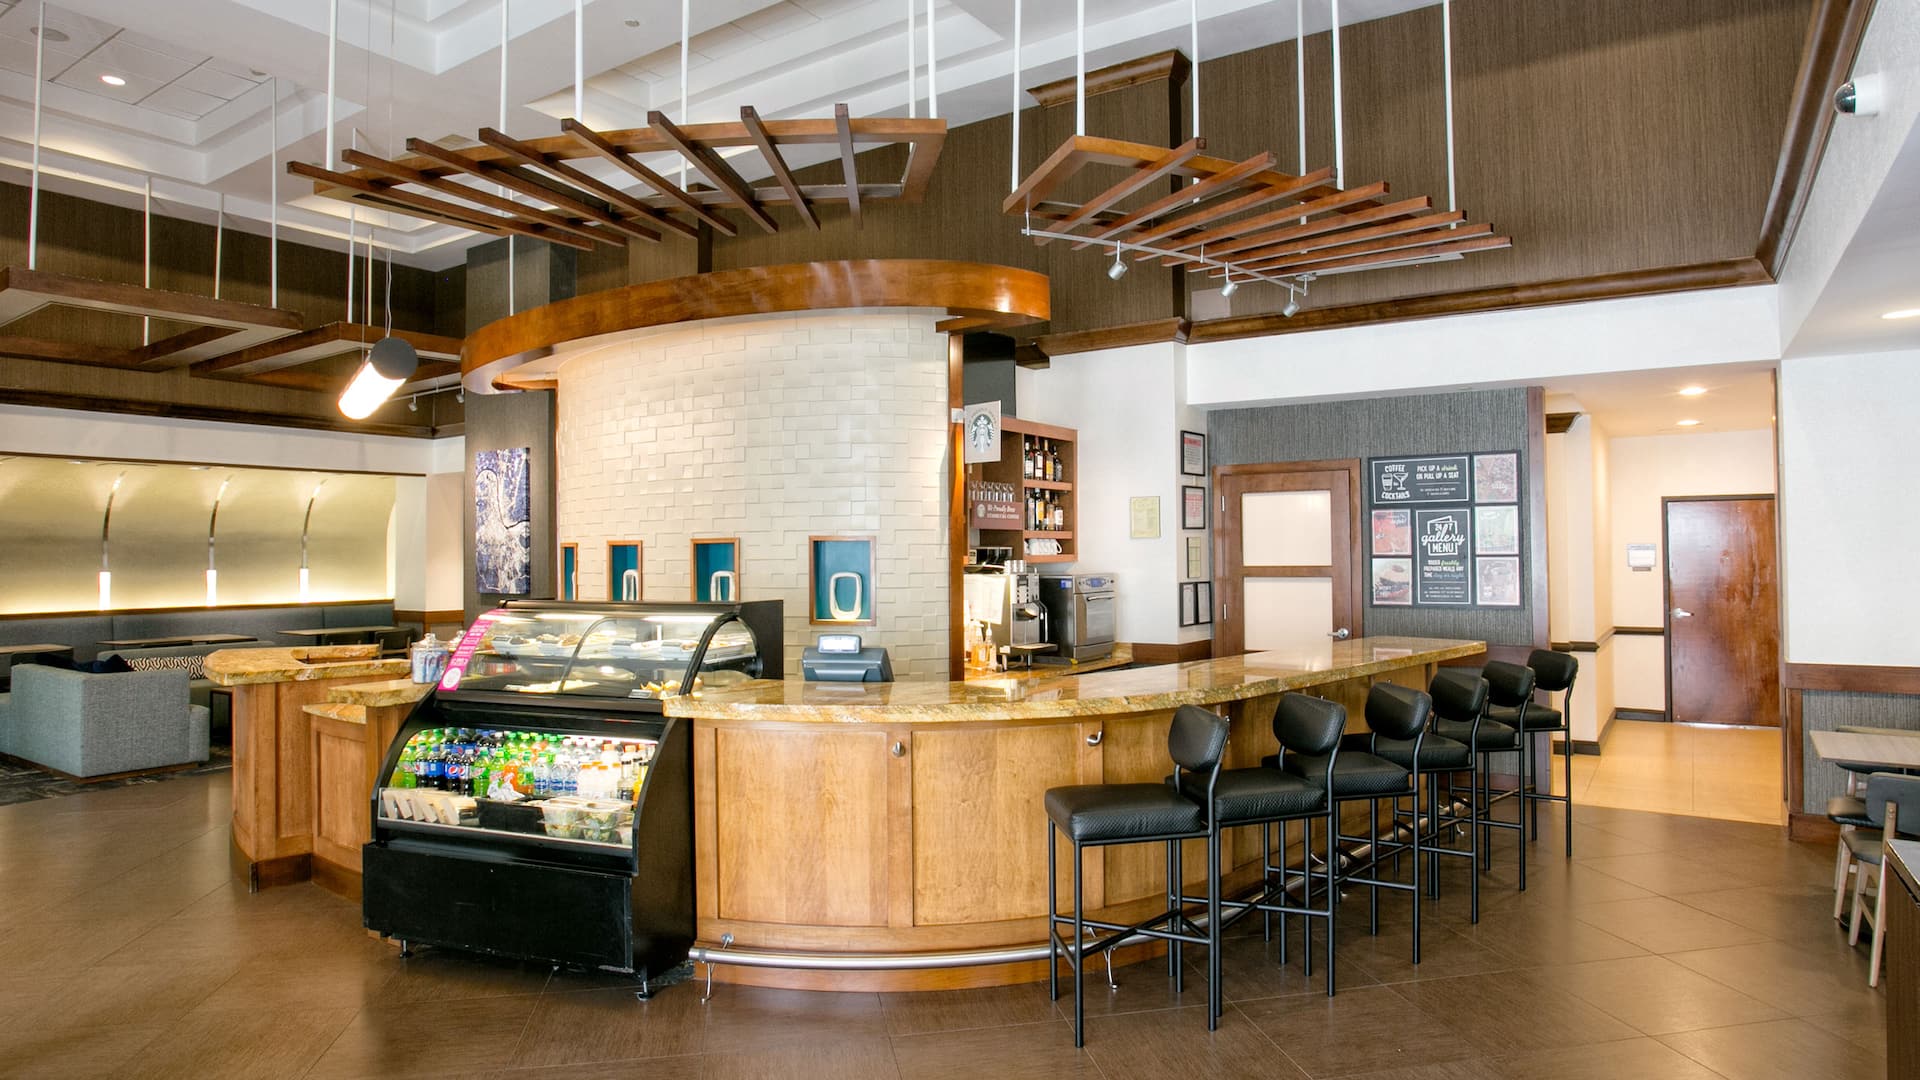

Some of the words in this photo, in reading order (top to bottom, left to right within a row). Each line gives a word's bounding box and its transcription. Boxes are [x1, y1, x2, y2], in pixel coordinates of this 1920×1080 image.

[1381, 490, 1410, 500] COCKTAILS
[1421, 525, 1465, 546] gallery
[1432, 542, 1454, 553] MENU
